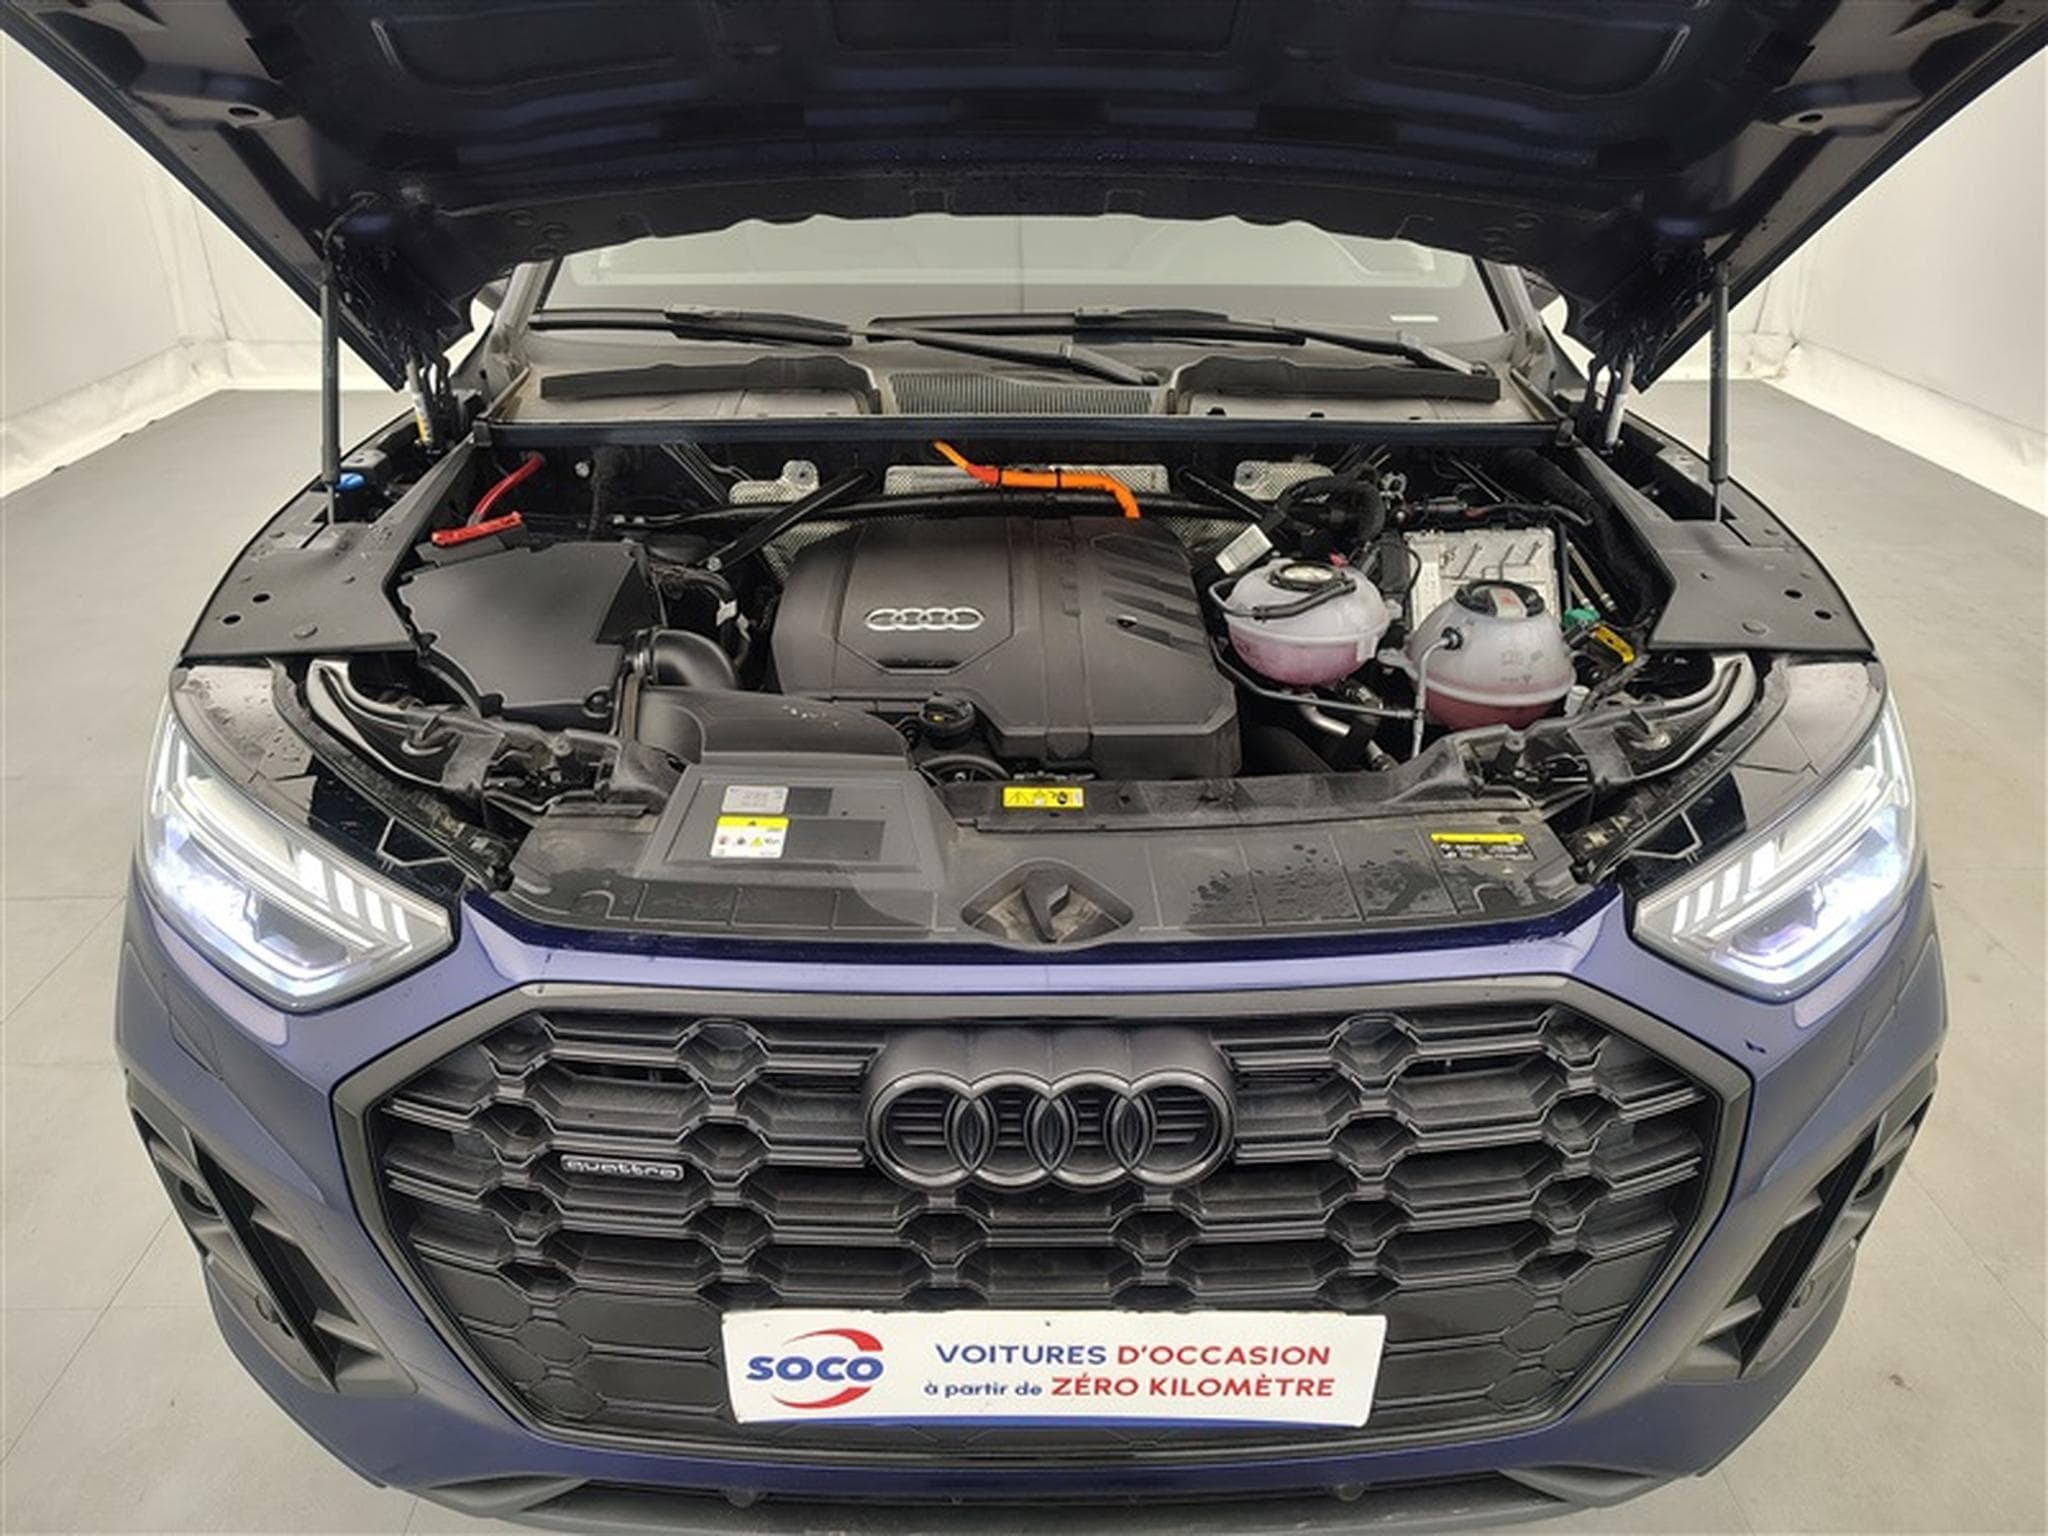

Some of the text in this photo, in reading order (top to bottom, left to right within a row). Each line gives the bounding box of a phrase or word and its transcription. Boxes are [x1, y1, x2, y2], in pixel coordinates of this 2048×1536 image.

[935, 1344, 1331, 1365] VOITURES D'OCCASION
[746, 1356, 884, 1382] SOCO
[923, 1372, 1336, 1399] à partir de ZÉRO KILOMÈTRE
